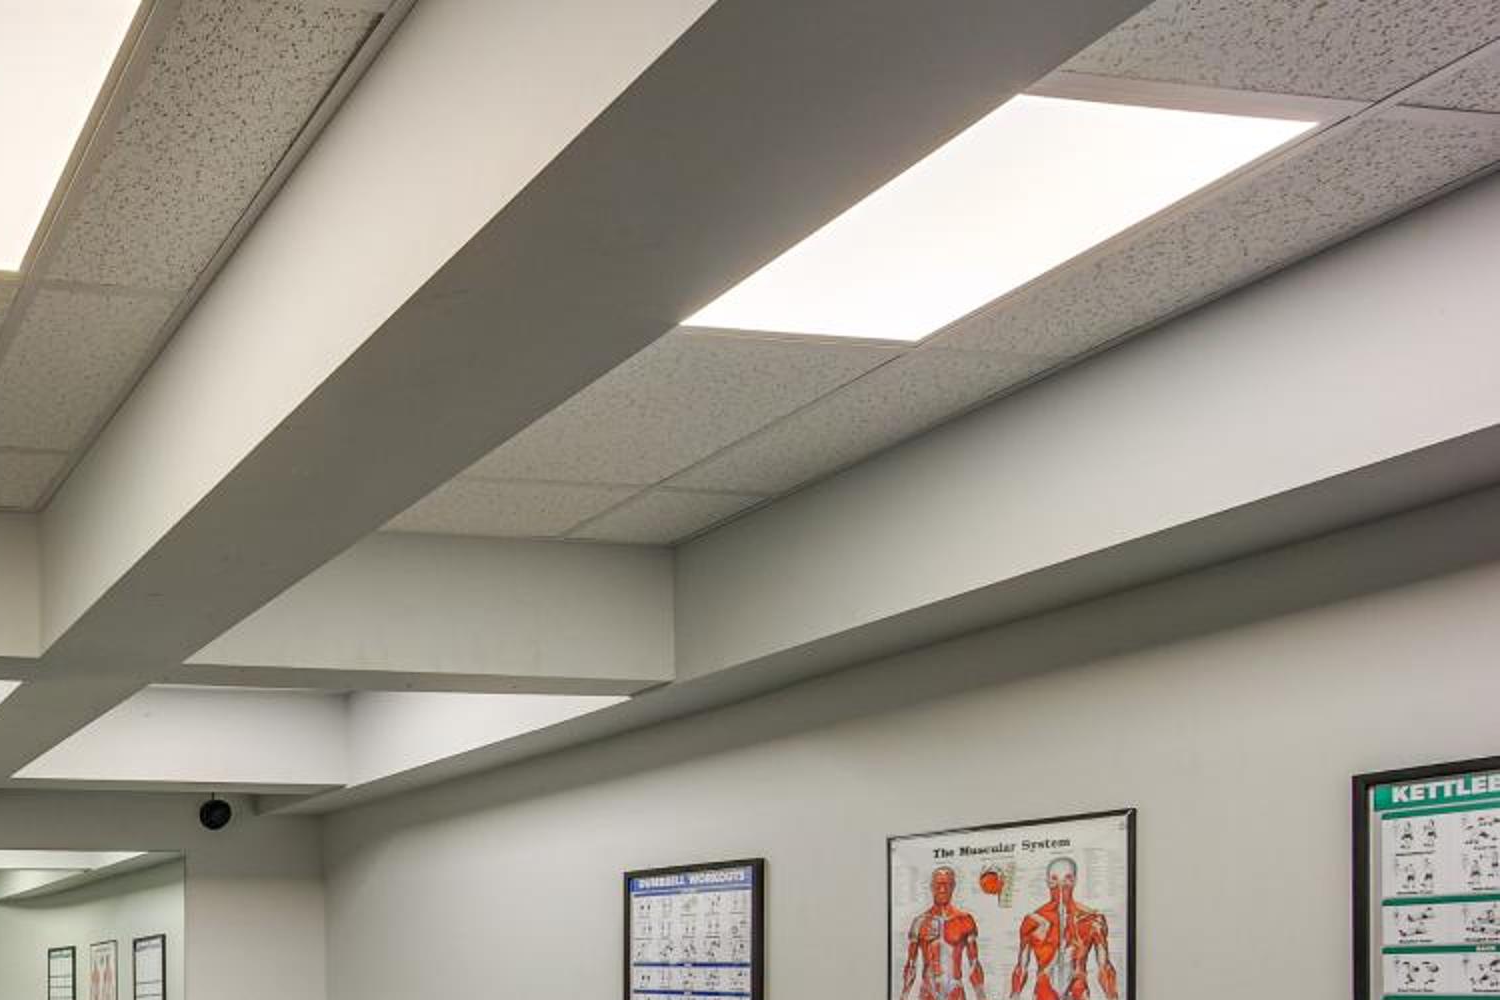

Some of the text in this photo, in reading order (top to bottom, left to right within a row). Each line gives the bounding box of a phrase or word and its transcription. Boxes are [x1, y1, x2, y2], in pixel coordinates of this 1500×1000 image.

[933, 838, 1071, 859] The Muscular System
